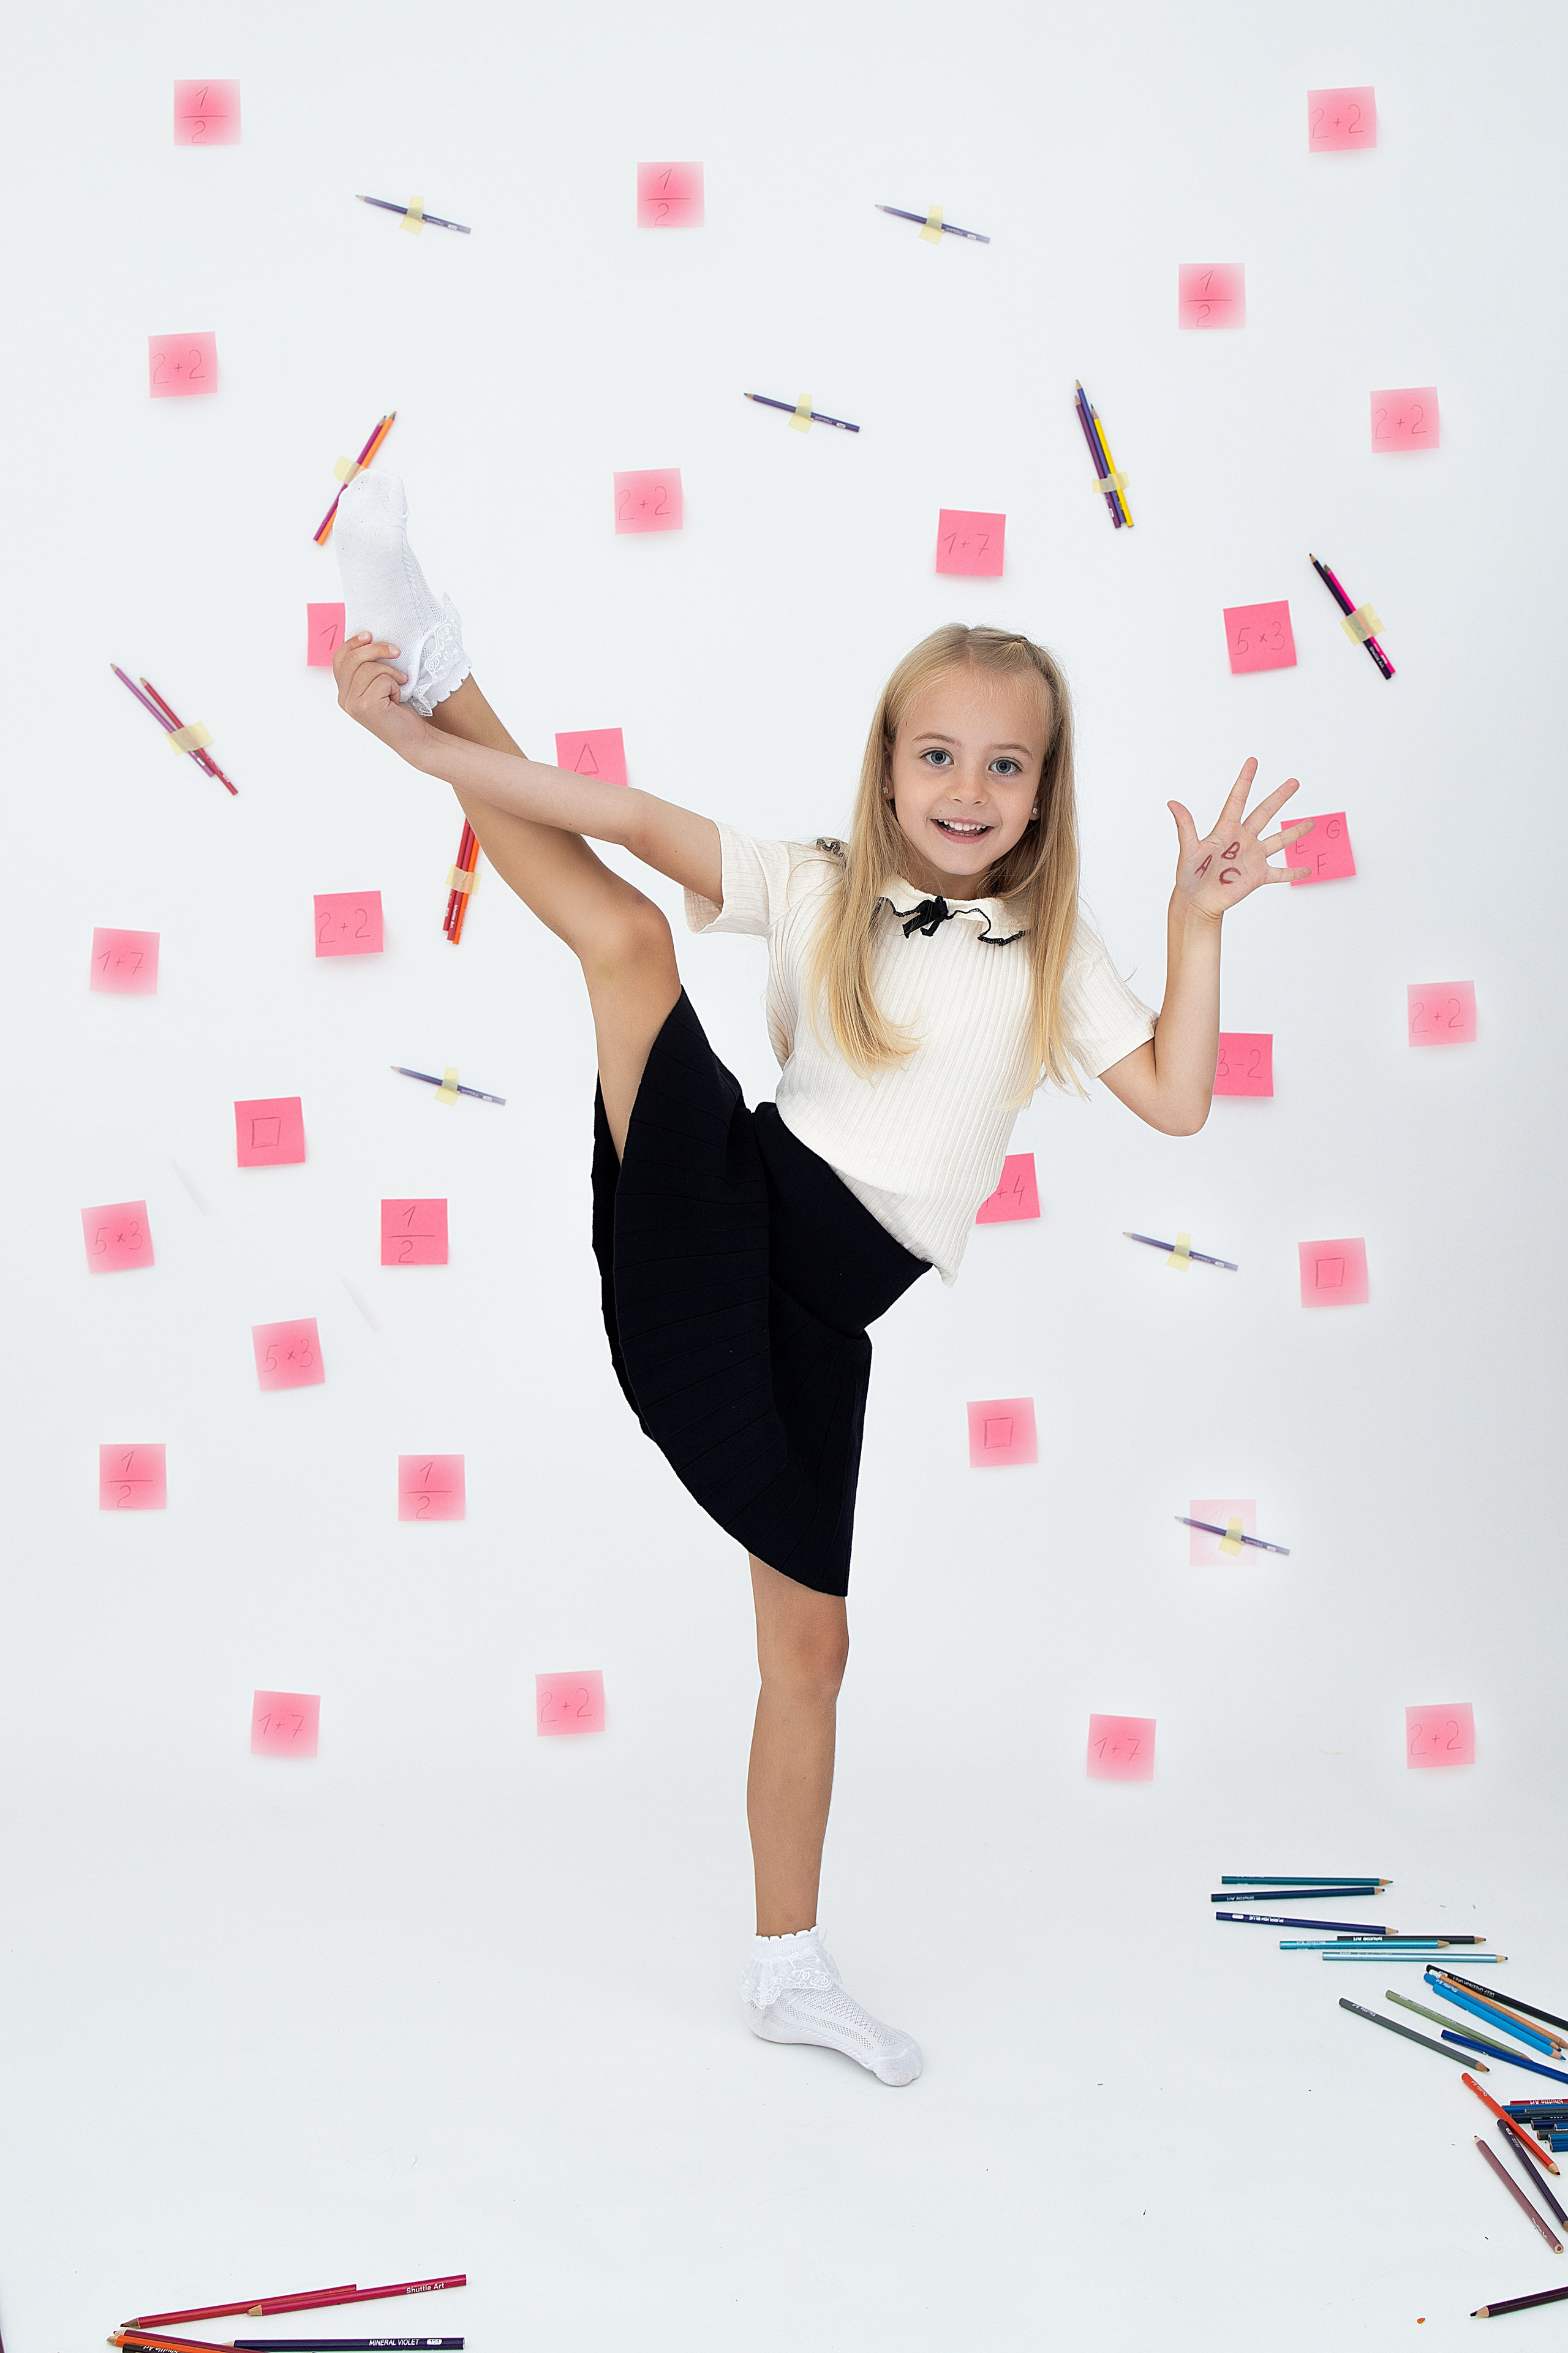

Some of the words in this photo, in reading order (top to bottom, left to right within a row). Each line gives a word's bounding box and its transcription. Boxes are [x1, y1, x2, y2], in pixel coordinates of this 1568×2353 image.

[190, 120, 208, 144] 2
[654, 202, 671, 227] 2
[1195, 304, 1213, 328] 2
[1325, 819, 1340, 839] G
[1220, 841, 1240, 860] B
[1194, 854, 1213, 879] A
[1317, 852, 1328, 875] F
[1218, 867, 1242, 885] C
[398, 1239, 415, 1264] 2
[116, 1484, 134, 1509] 2
[415, 1495, 432, 1519] 2
[406, 2285, 431, 2294] Shuttle
